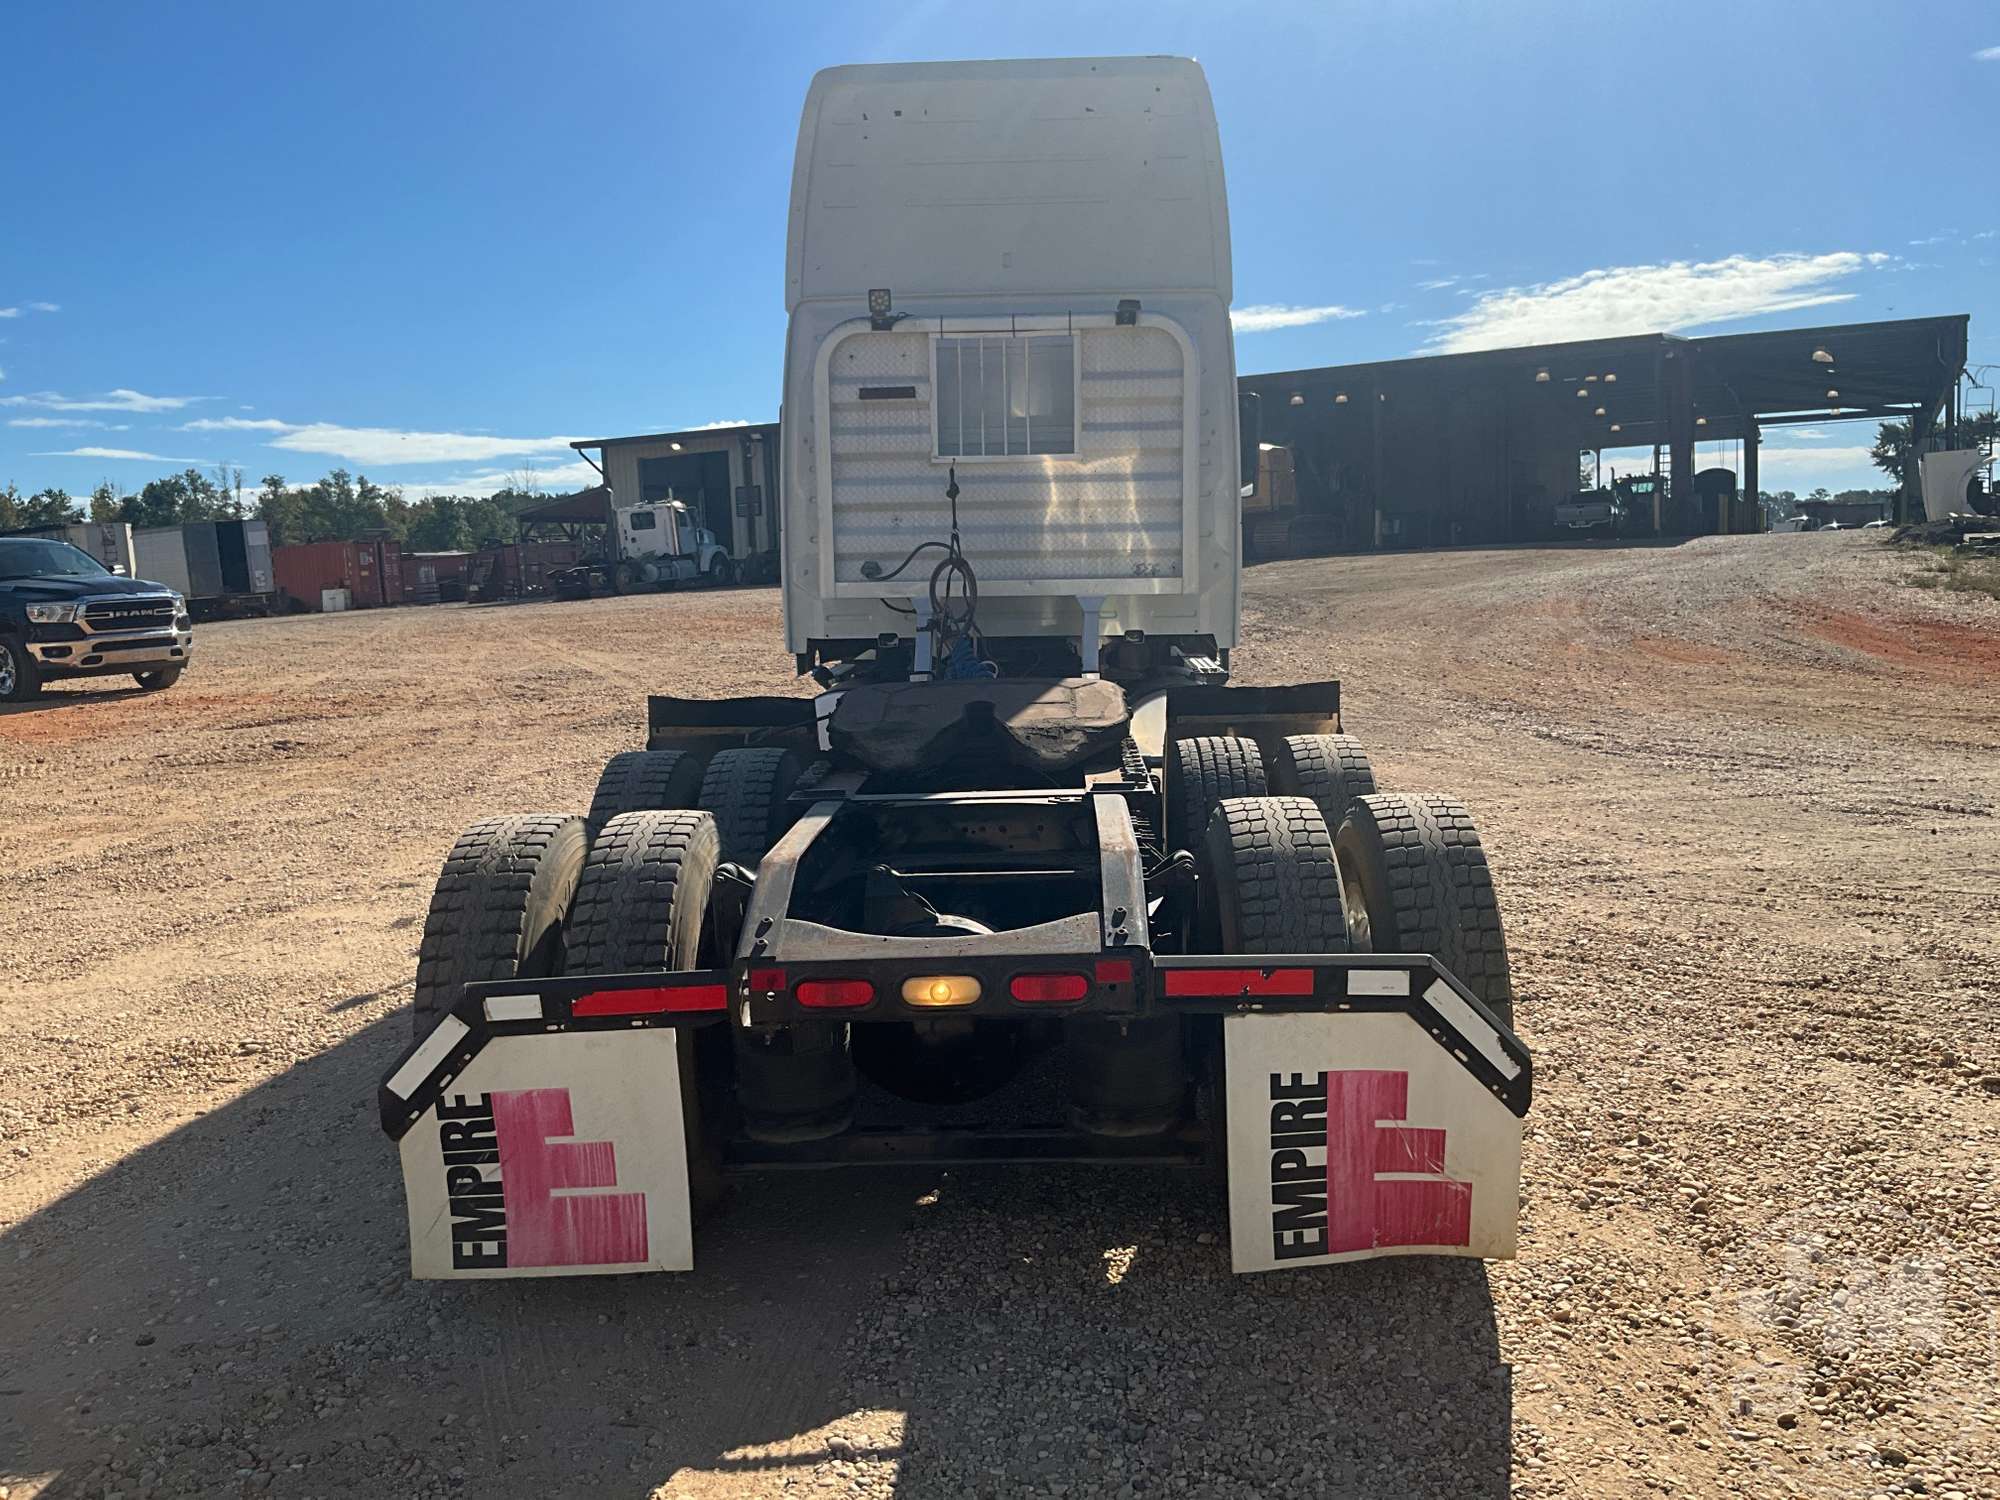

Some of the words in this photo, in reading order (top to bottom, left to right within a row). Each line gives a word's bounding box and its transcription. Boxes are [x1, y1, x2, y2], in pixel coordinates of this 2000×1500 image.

[115, 609, 153, 617] RAM
[434, 1091, 509, 1270] EMPIRE
[1270, 1071, 1329, 1260] EMPIRE
